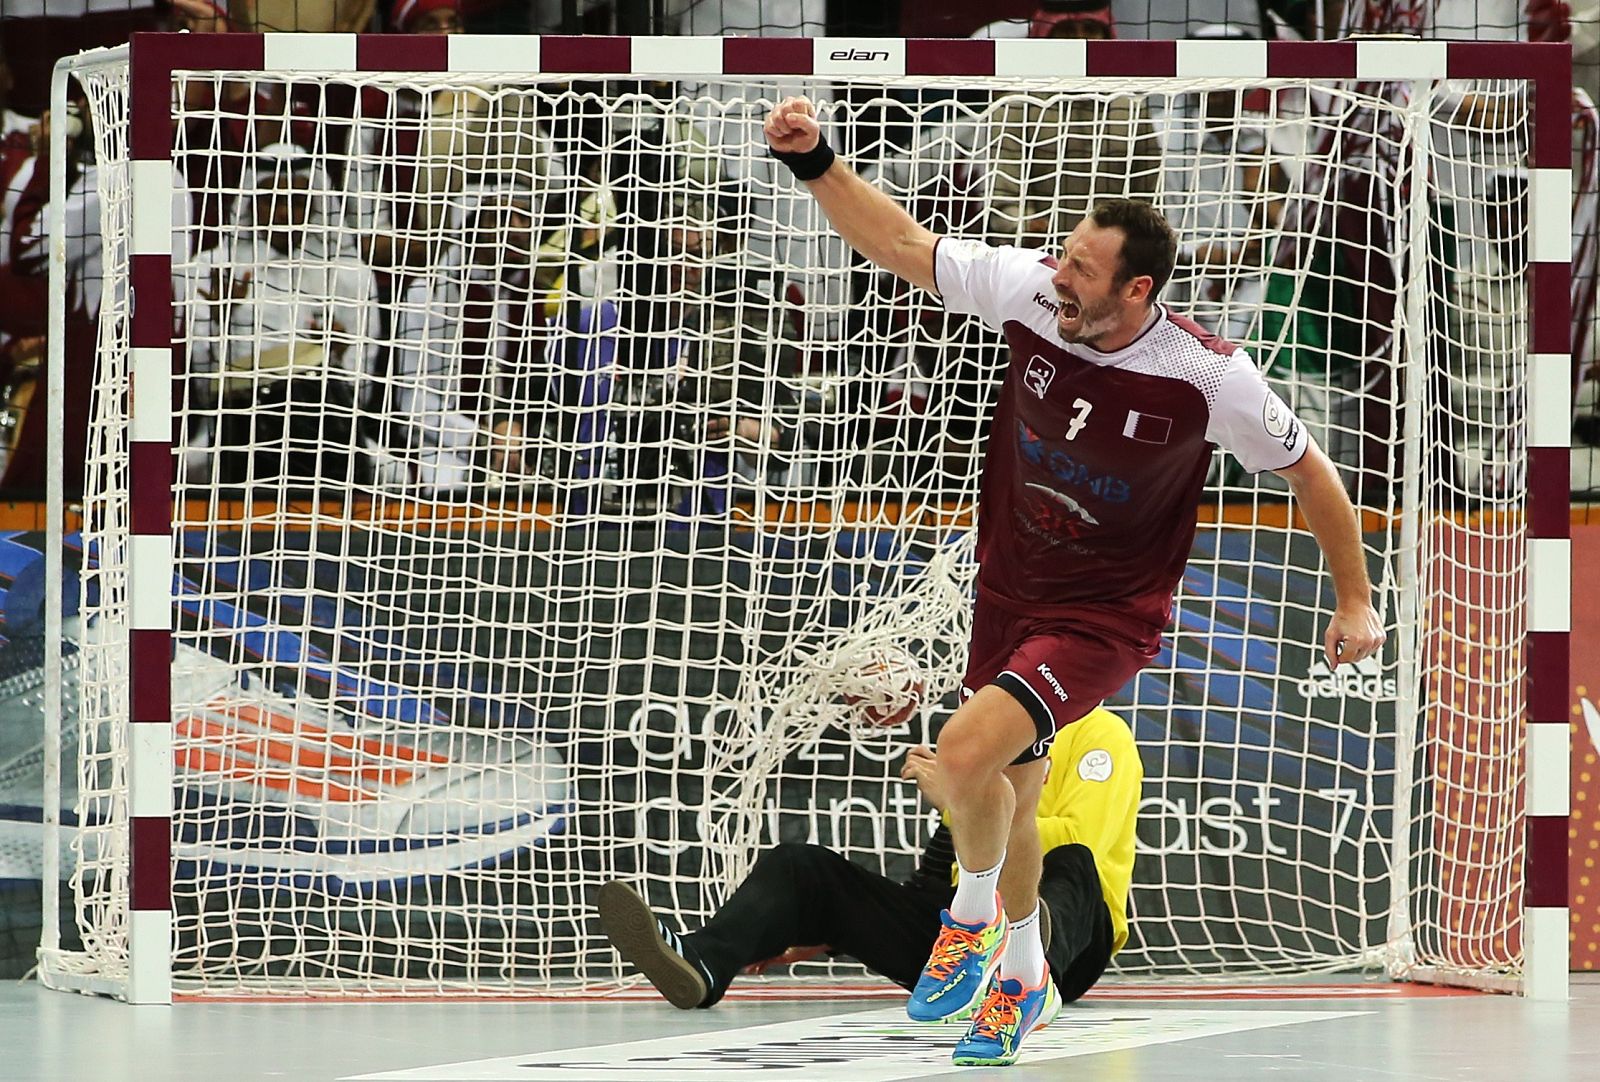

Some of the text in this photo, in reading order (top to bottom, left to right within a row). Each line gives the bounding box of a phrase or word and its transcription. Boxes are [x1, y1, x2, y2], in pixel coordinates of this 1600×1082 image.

[829, 48, 890, 62] elan
[1032, 291, 1059, 317] Kem
[1065, 397, 1093, 441] 7
[1036, 663, 1069, 702] Kempa
[1297, 673, 1397, 699] adidas
[629, 682, 946, 762] adizer
[1318, 788, 1358, 855] 7
[926, 969, 967, 1003] GEL-BLAST
